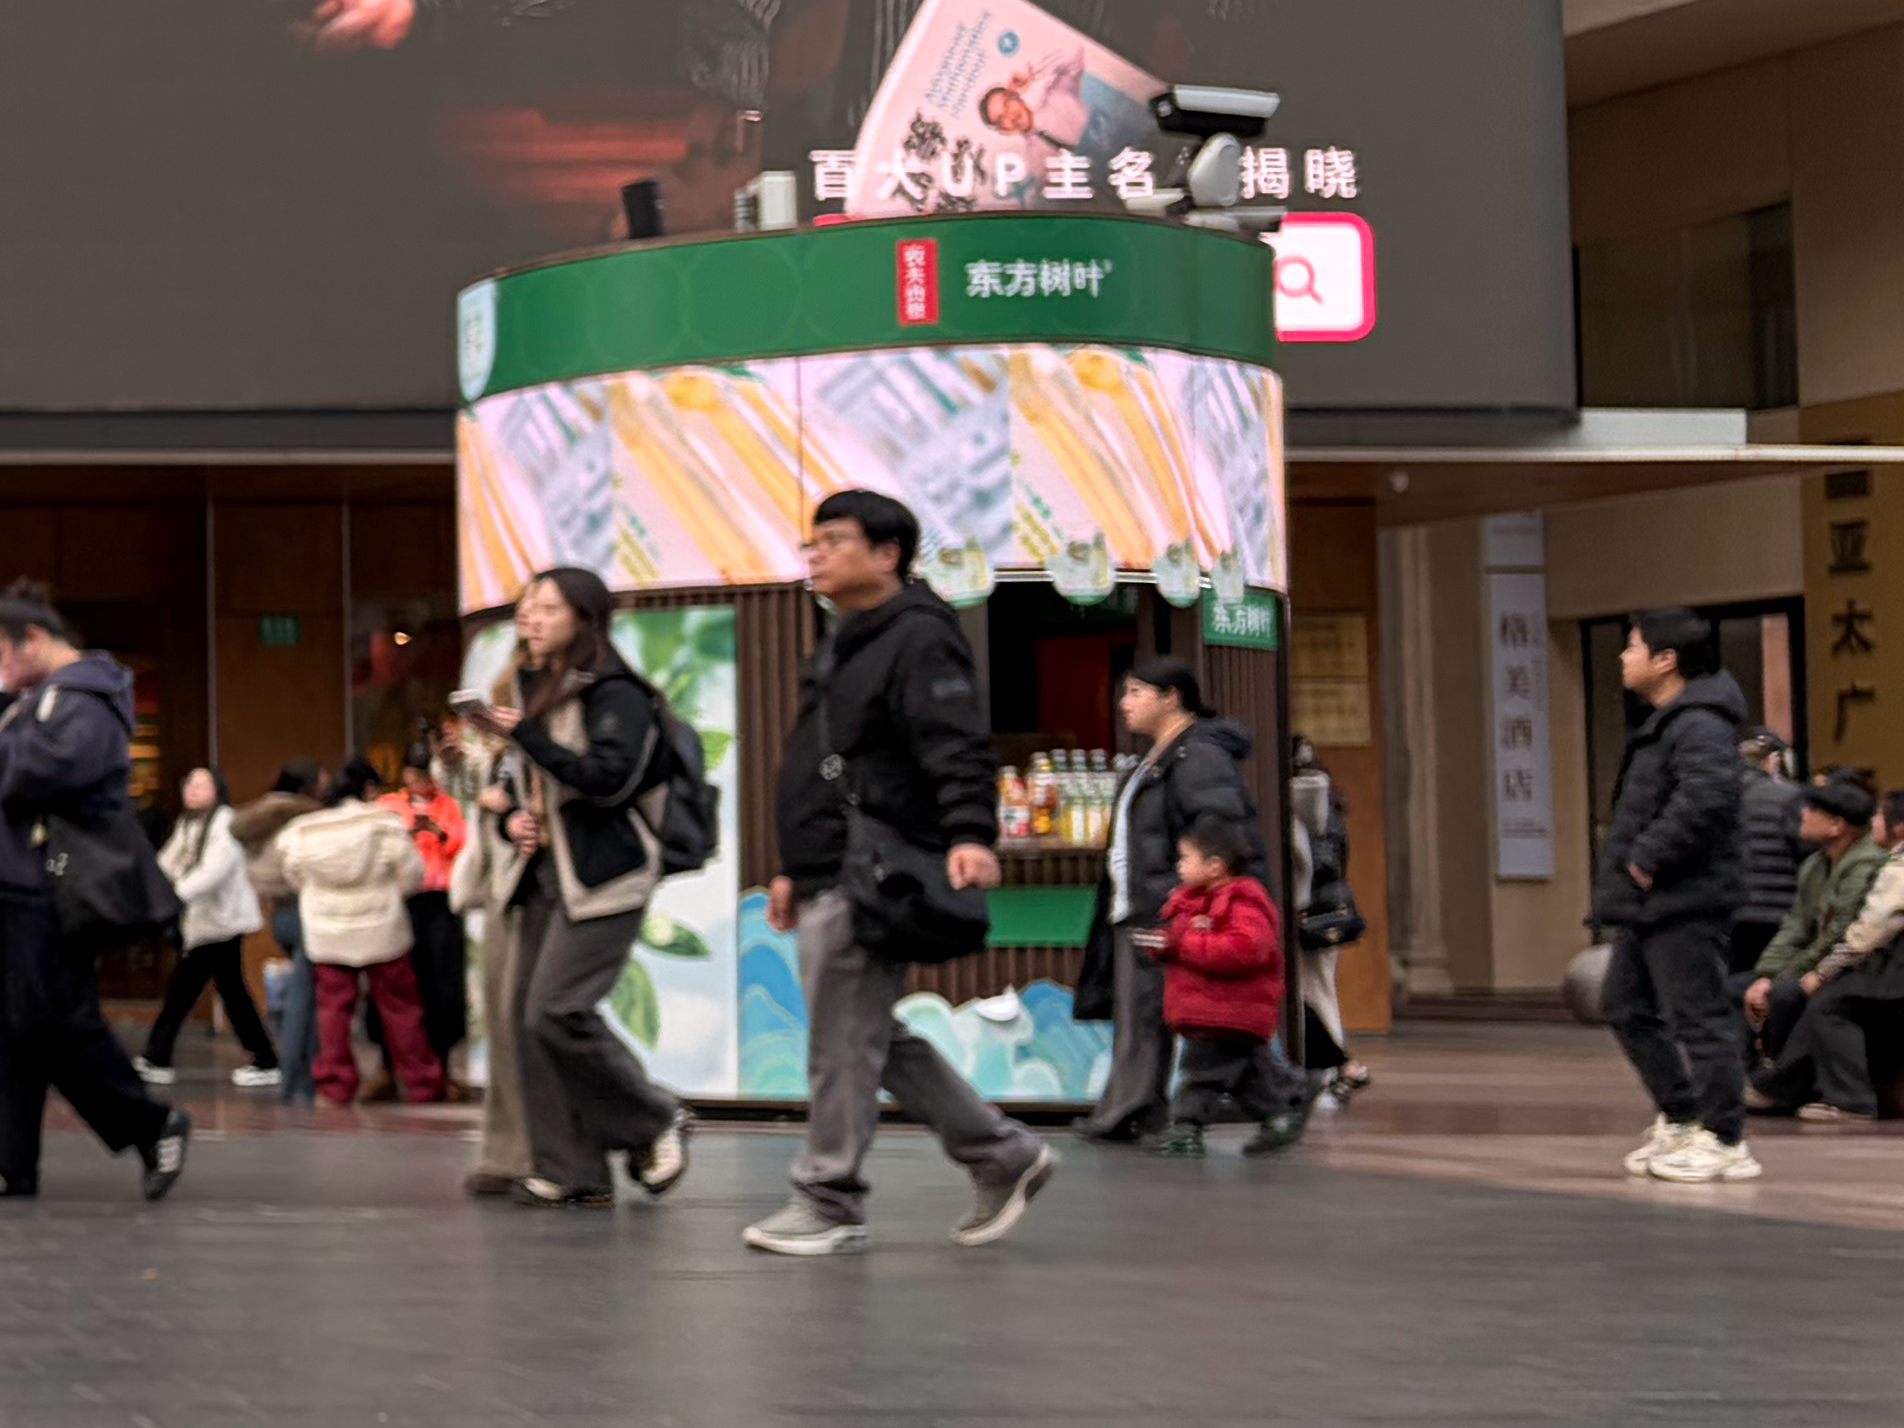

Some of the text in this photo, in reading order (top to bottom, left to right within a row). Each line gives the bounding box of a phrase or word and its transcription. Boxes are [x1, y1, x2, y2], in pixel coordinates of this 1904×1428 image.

[810, 144, 1359, 203] 百大UP主名揭晓
[964, 258, 1106, 299] 东方树叶
